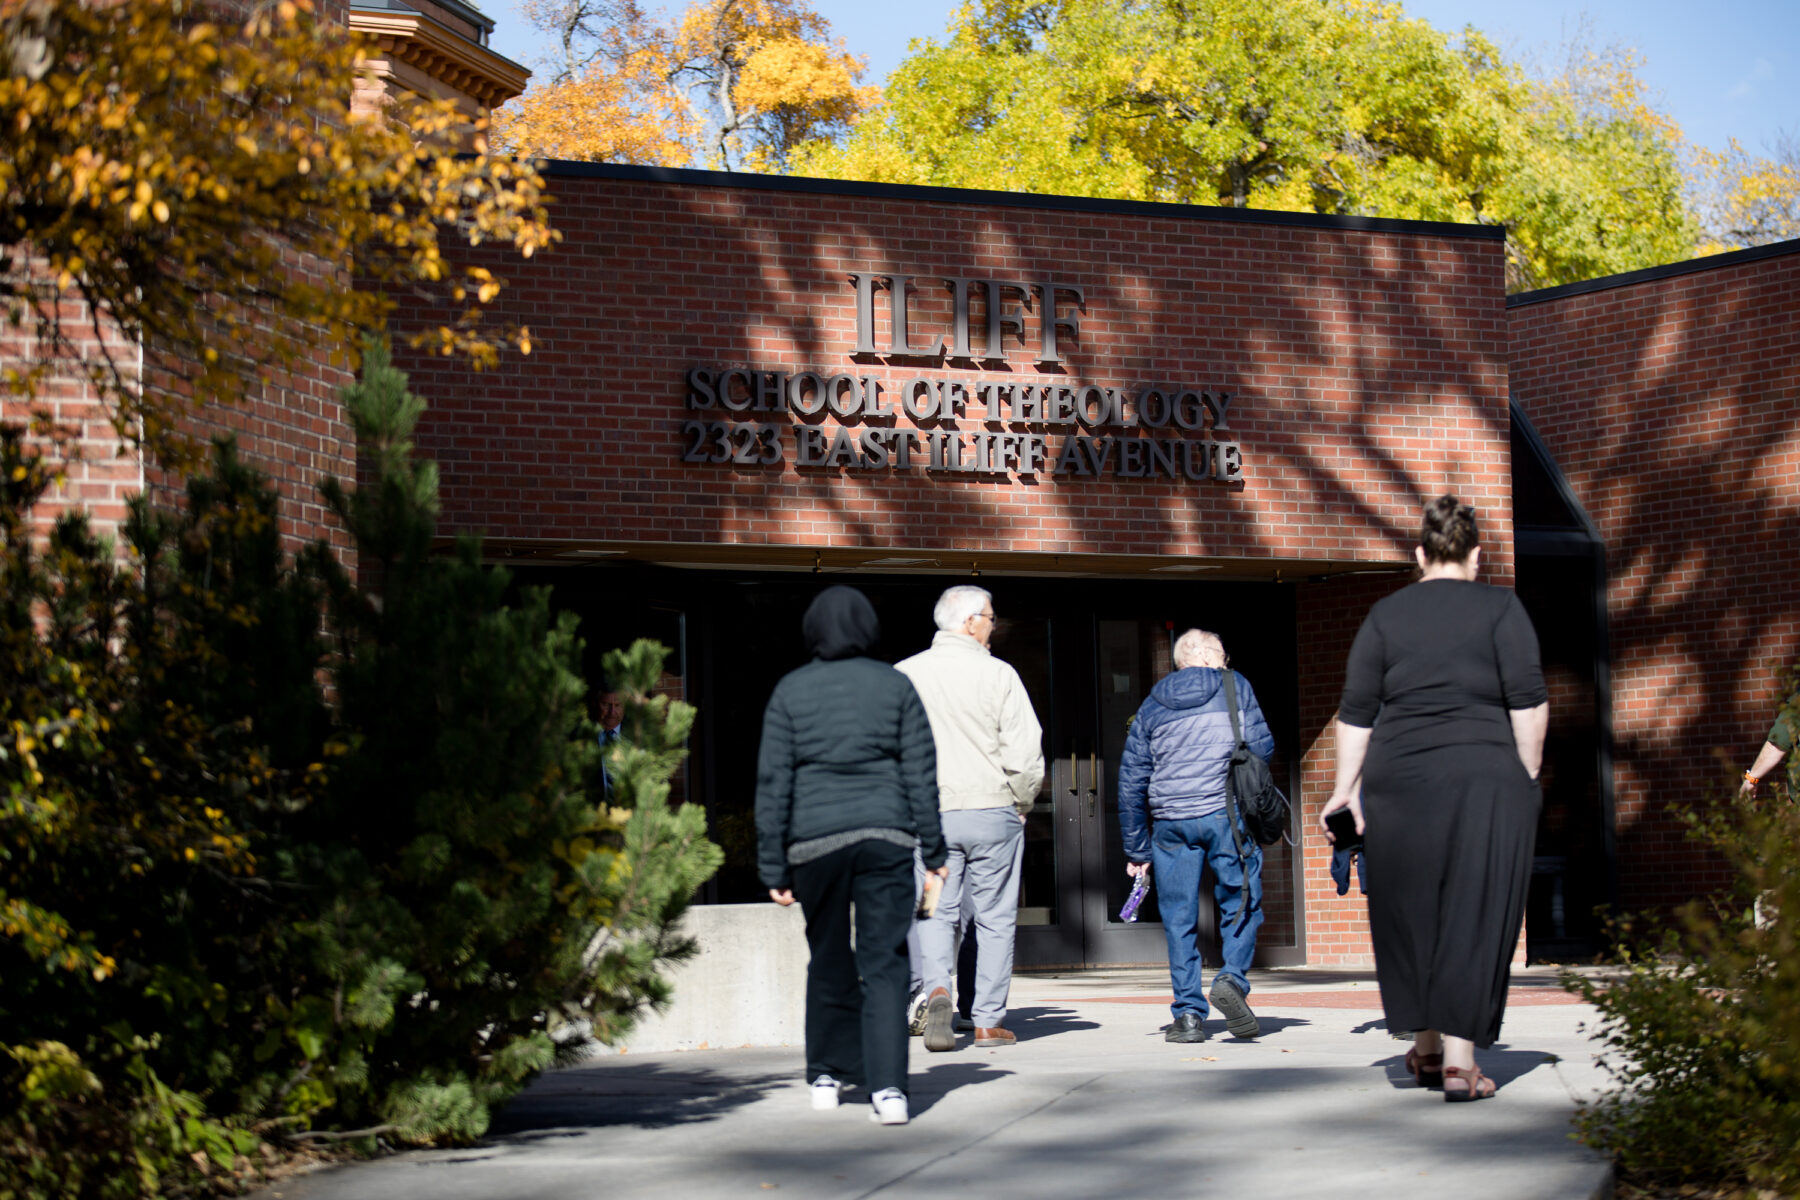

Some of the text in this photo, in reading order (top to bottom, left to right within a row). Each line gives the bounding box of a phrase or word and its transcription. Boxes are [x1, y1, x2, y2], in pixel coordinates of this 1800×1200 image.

[847, 272, 1084, 363] ILIFF
[686, 367, 1238, 431] SCHOOL OF THEOLOGY
[684, 421, 1244, 481] 2323 EAST ILIFF AVENUE
